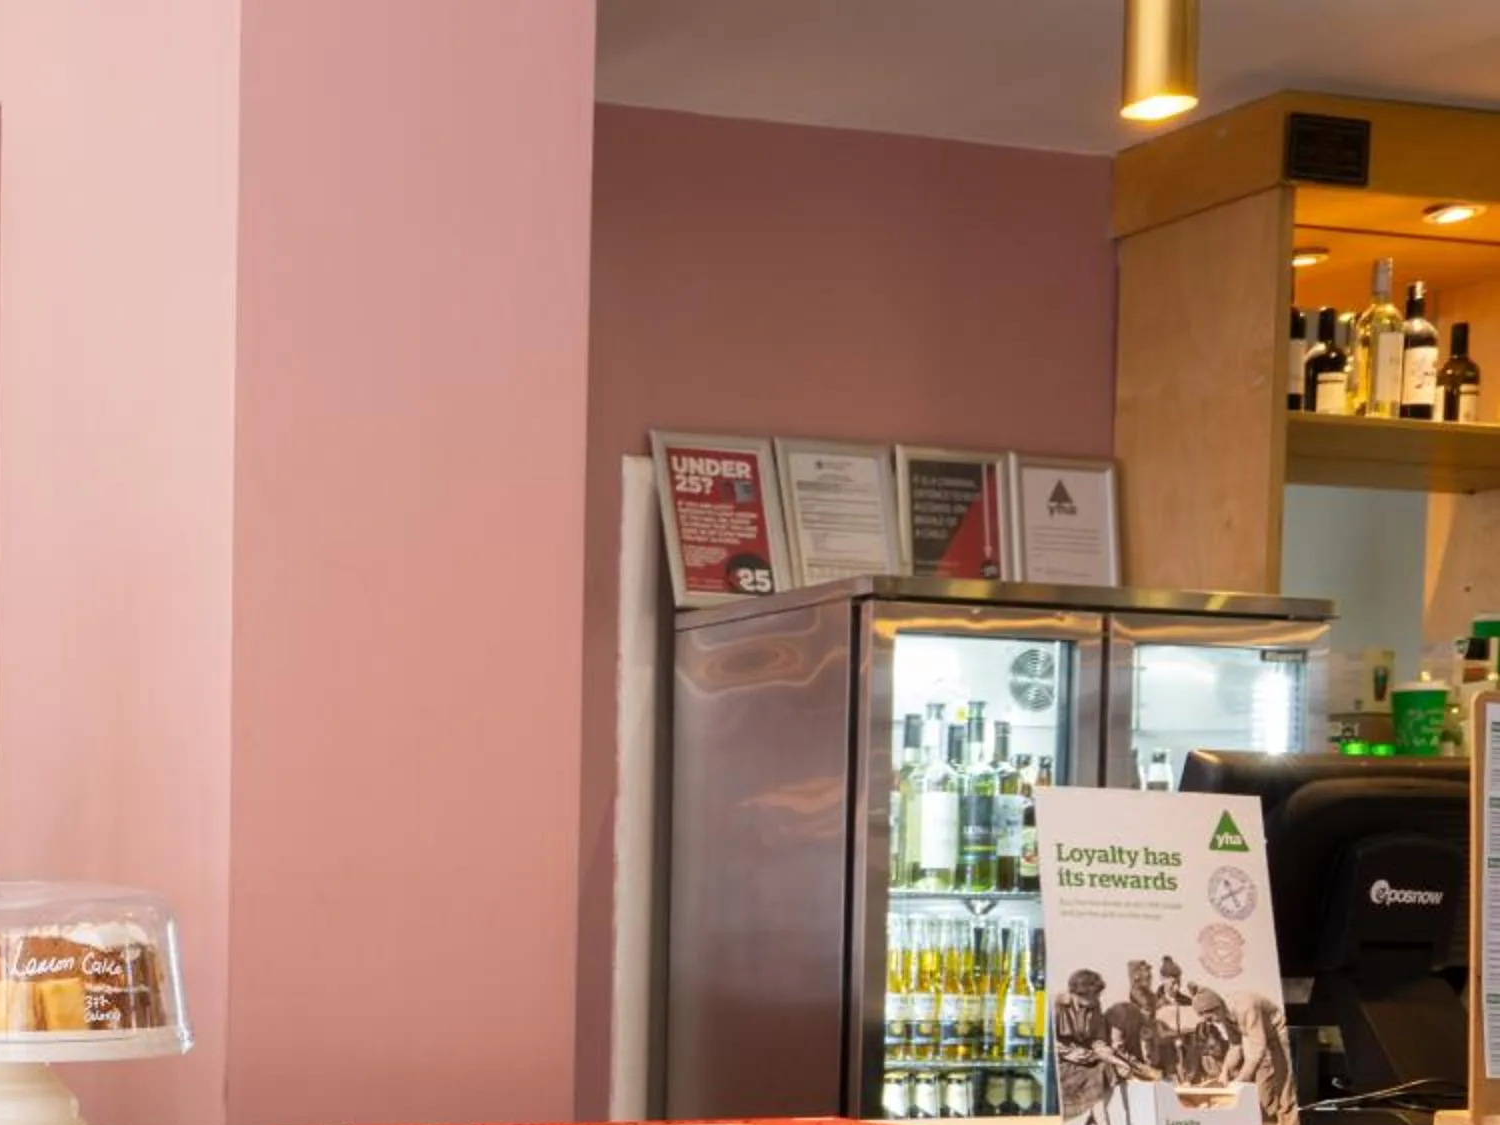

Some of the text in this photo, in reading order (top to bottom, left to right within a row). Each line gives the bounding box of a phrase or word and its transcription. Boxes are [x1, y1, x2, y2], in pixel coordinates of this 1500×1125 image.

[671, 456, 752, 479] UNDER
[675, 475, 713, 495] 25?
[736, 567, 772, 593] 25
[1216, 831, 1244, 848] yha
[1056, 843, 1183, 868] Loyalty has
[1058, 868, 1178, 891] its rewards
